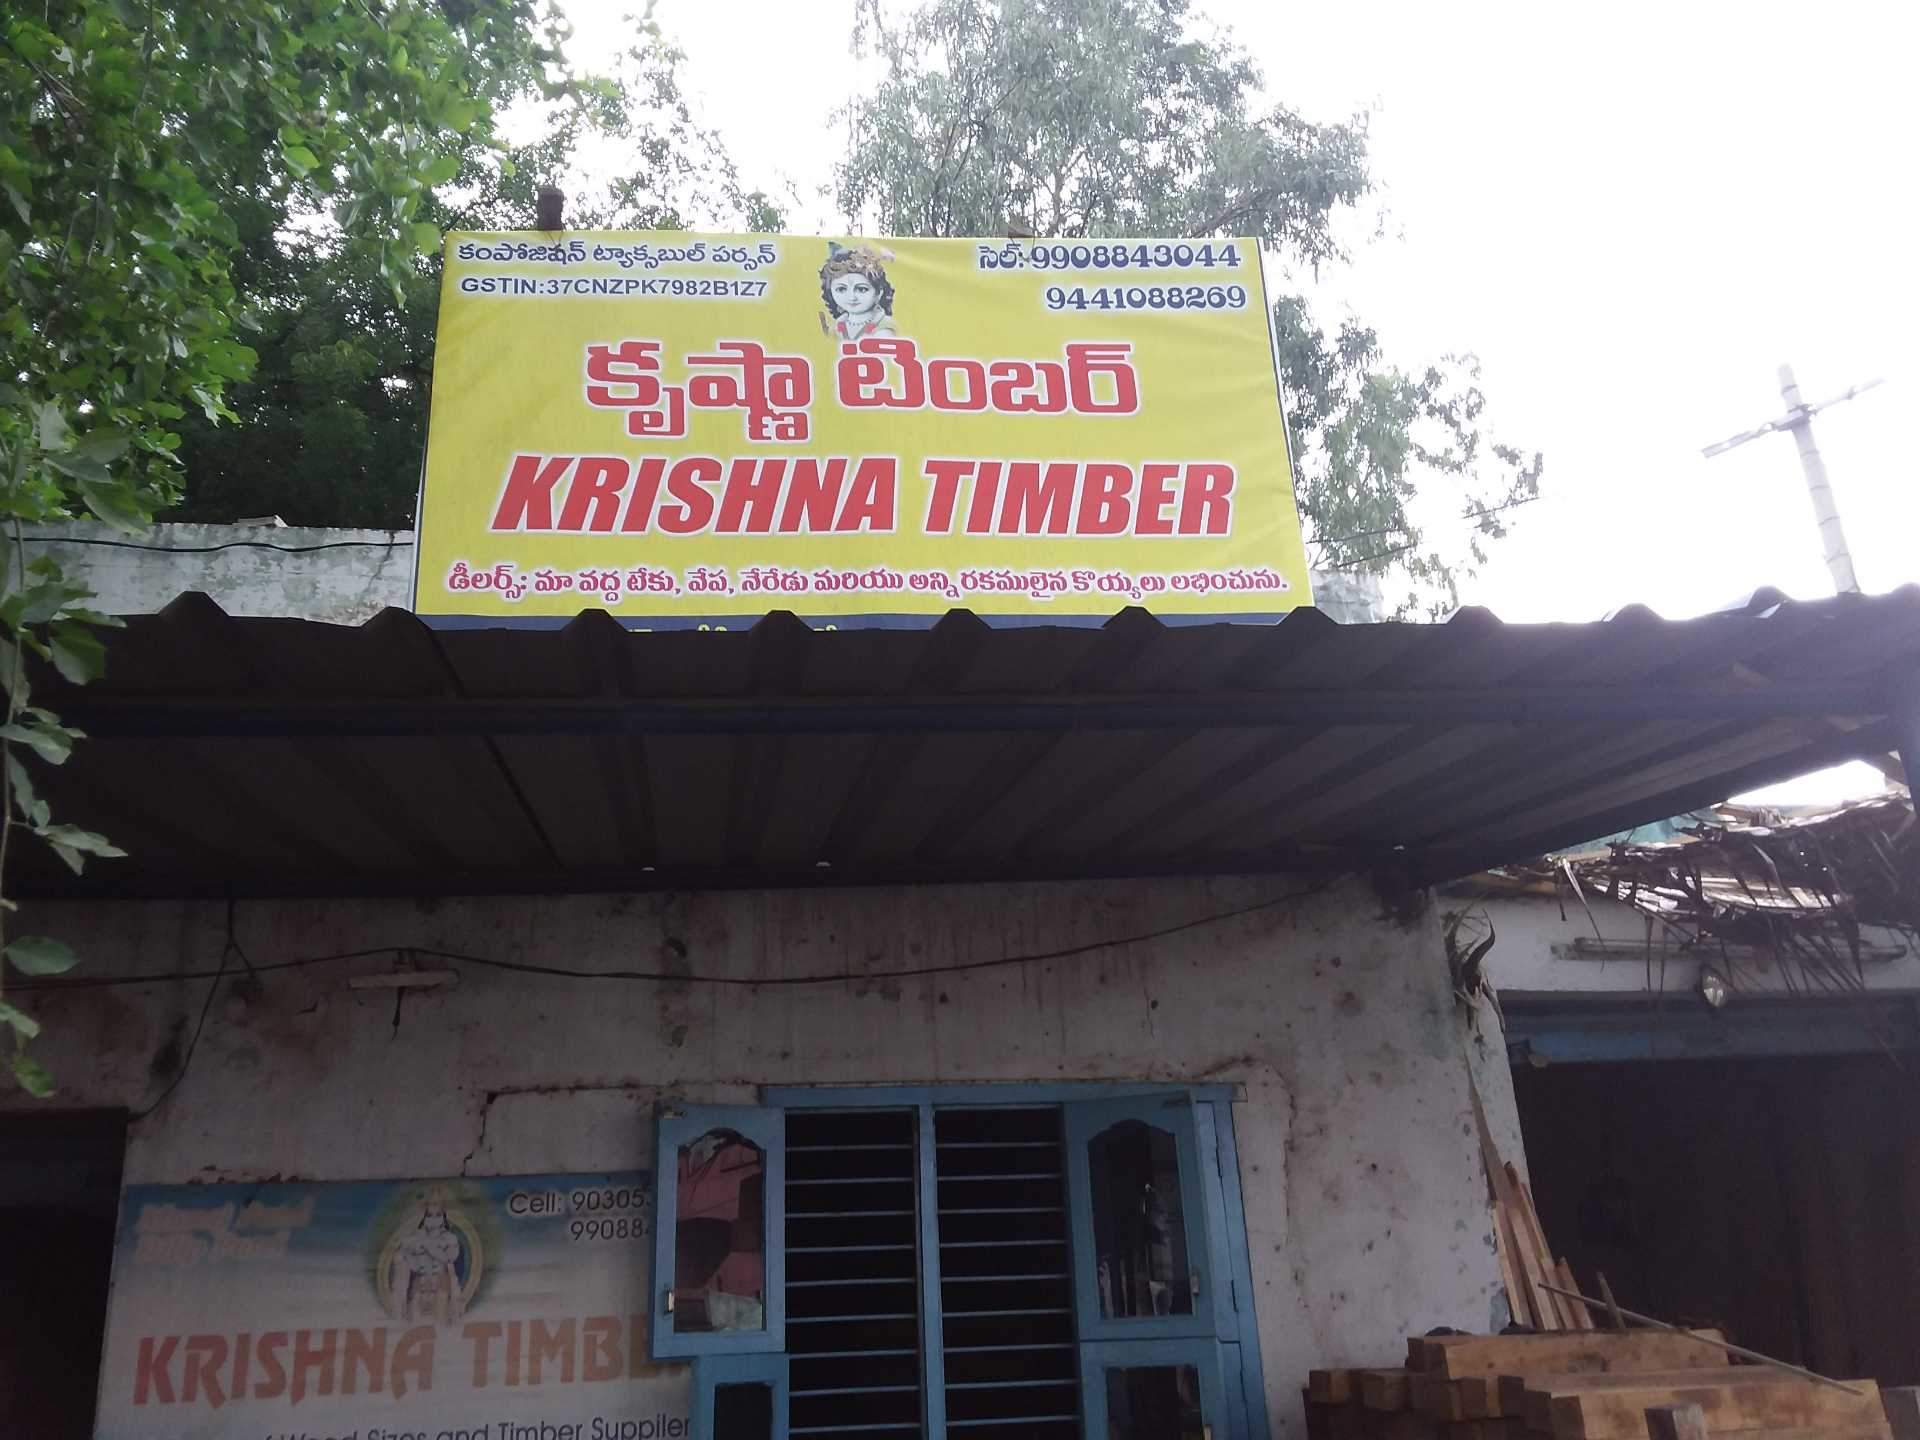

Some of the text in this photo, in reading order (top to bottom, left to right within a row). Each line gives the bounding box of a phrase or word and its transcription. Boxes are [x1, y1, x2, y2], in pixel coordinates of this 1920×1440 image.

[458, 241, 586, 265] కంపోజిషన్
[712, 244, 776, 271] పర్సన్
[461, 277, 767, 297] GSTIN:37CNZPK7982B1Z7
[1046, 286, 1246, 310] 9441088269
[586, 338, 1139, 441] కృష్ణా టింబర్
[491, 455, 1235, 536] KRISHNA TIMBER
[534, 570, 573, 592] మా
[579, 570, 620, 601] వద్ద
[742, 567, 808, 592] నేరేడు
[814, 569, 903, 591] మరియు
[909, 571, 959, 598] అన్ని
[510, 1189, 651, 1214] Cell: 90305
[570, 1218, 649, 1241] 99088
[133, 1326, 435, 1409] KRISHNA
